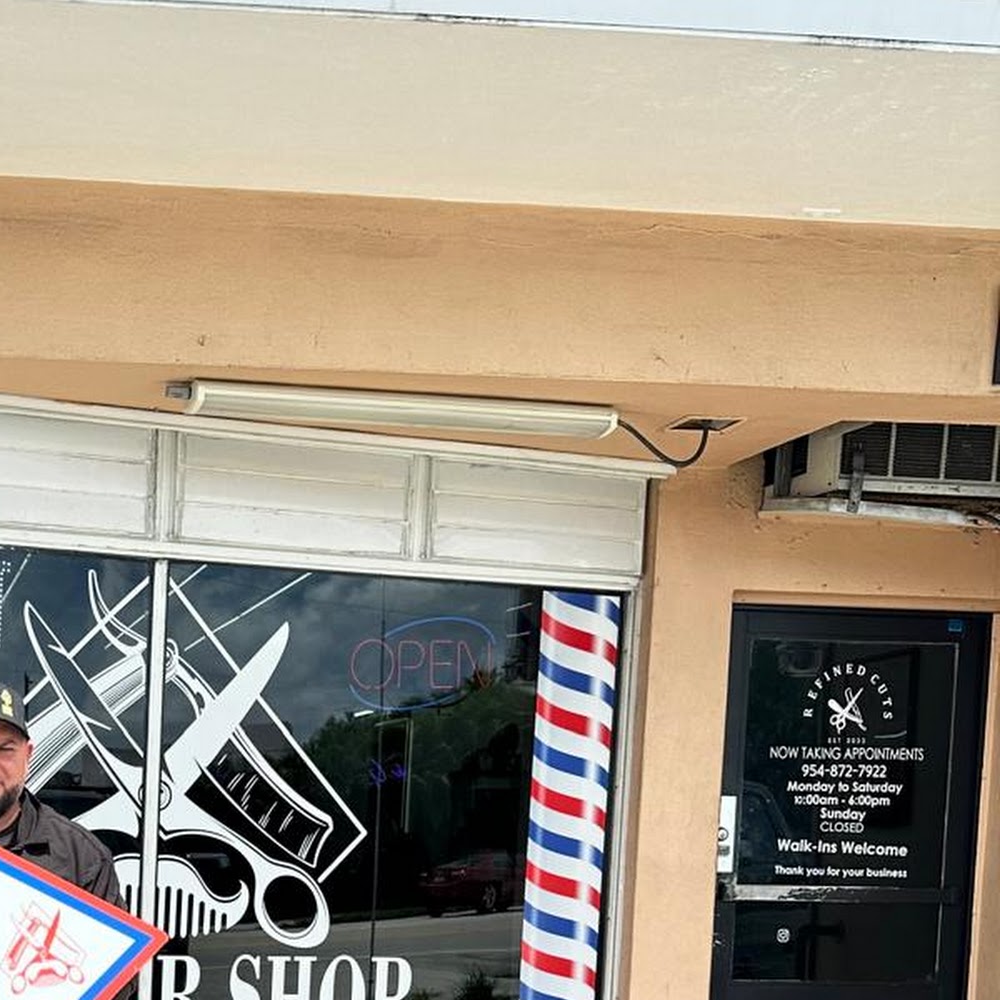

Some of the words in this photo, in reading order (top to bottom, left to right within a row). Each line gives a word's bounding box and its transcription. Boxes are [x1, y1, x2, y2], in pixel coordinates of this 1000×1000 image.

[350, 638, 494, 690] OPEN
[803, 663, 867, 718] REFINED
[869, 673, 894, 720] CUTS
[769, 745, 799, 760] NOW
[801, 746, 842, 760] TAKING
[843, 746, 925, 761] APPOINTMENTS
[801, 763, 888, 778] 954-872-7922
[786, 780, 836, 795] Monday
[837, 781, 850, 793] to
[851, 781, 904, 796] Saturday
[847, 794, 891, 808] 6:00pm
[819, 807, 867, 822] Sunday
[819, 820, 865, 834] CLOSED
[777, 838, 838, 854] Walk-Ins
[840, 840, 908, 857] Welcome
[774, 864, 804, 876] Thank
[805, 866, 826, 878] you
[826, 865, 841, 877] for
[841, 868, 865, 879] your
[866, 867, 908, 878] business
